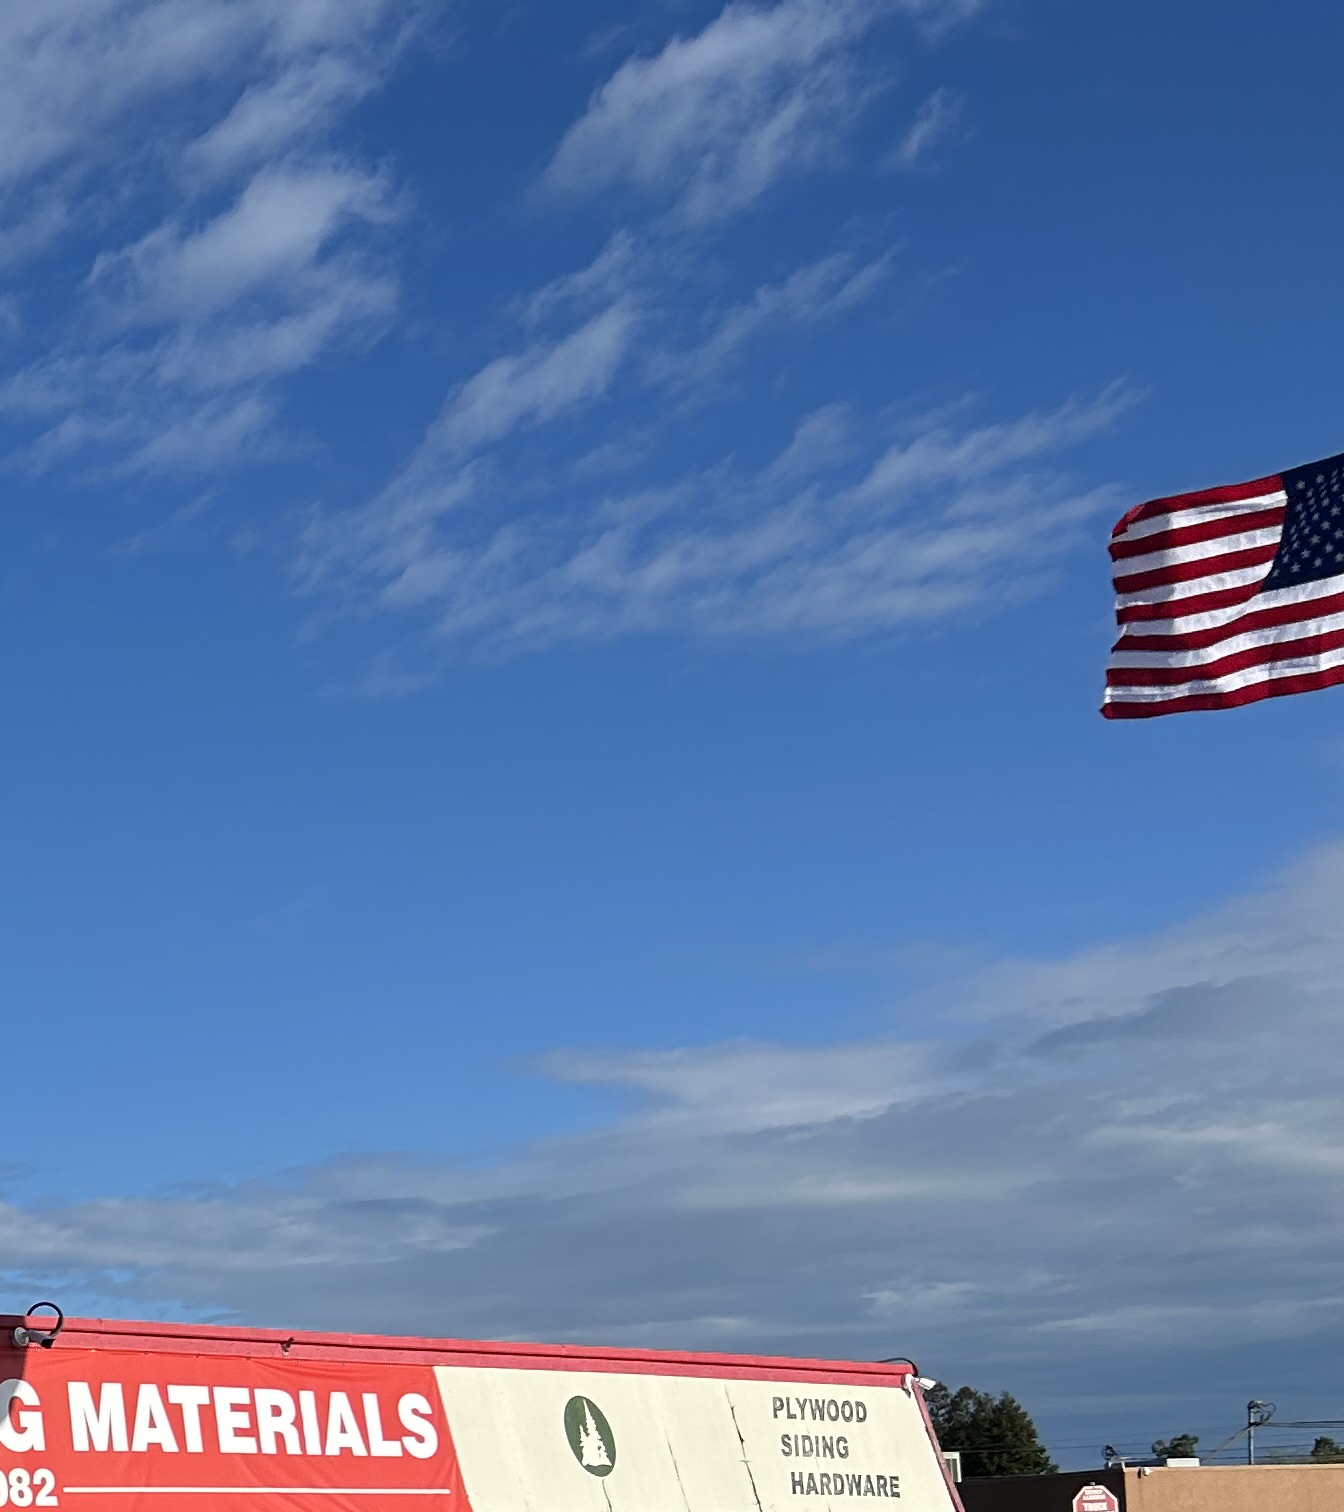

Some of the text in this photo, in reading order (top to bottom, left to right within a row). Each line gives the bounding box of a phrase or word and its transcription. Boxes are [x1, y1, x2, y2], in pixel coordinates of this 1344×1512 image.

[67, 1381, 439, 1459] MATERIALS
[772, 1396, 868, 1423] PLYWOOD
[780, 1433, 850, 1460] SIDING
[790, 1471, 901, 1499] HARDWARE
